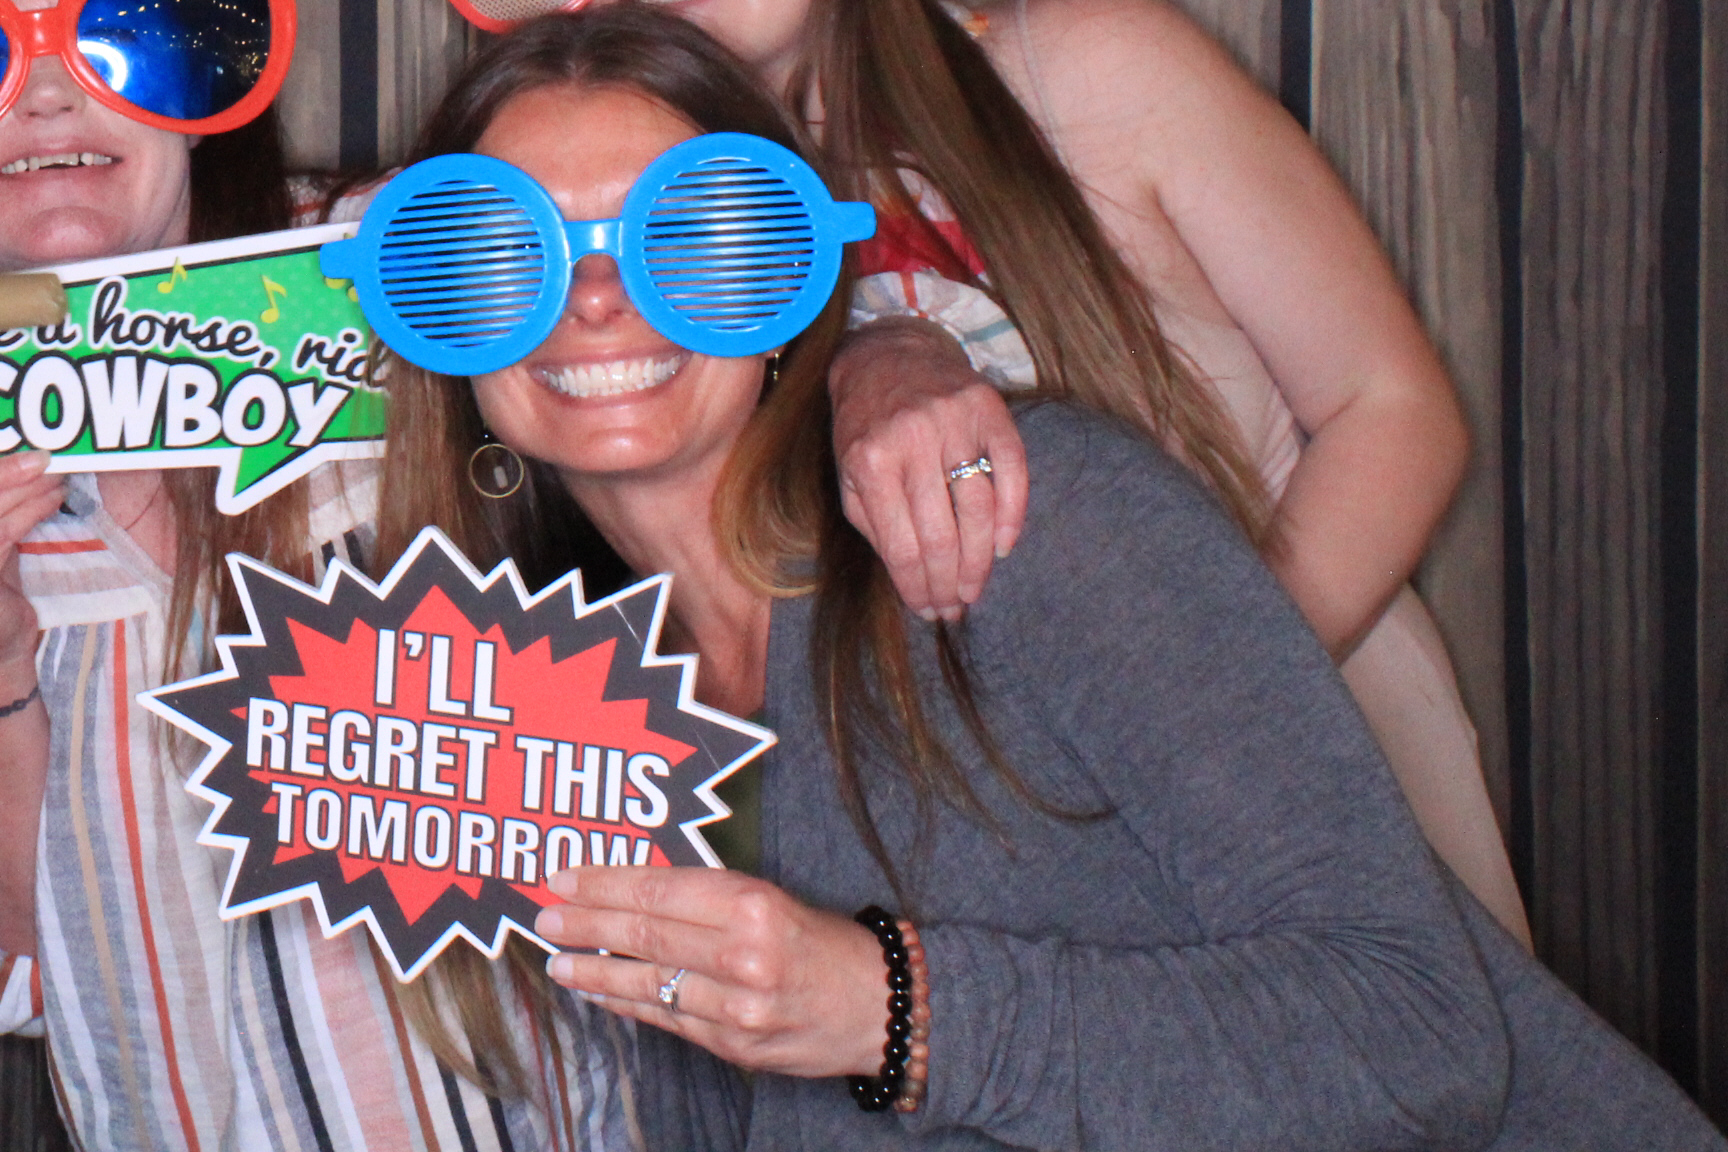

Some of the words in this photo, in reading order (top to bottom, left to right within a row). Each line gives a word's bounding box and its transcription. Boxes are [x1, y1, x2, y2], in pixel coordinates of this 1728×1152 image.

[92, 280, 275, 368] horse,
[295, 332, 390, 389] rid
[375, 628, 513, 723] I'LL
[245, 696, 497, 803] REGRET
[515, 735, 671, 829] THIS
